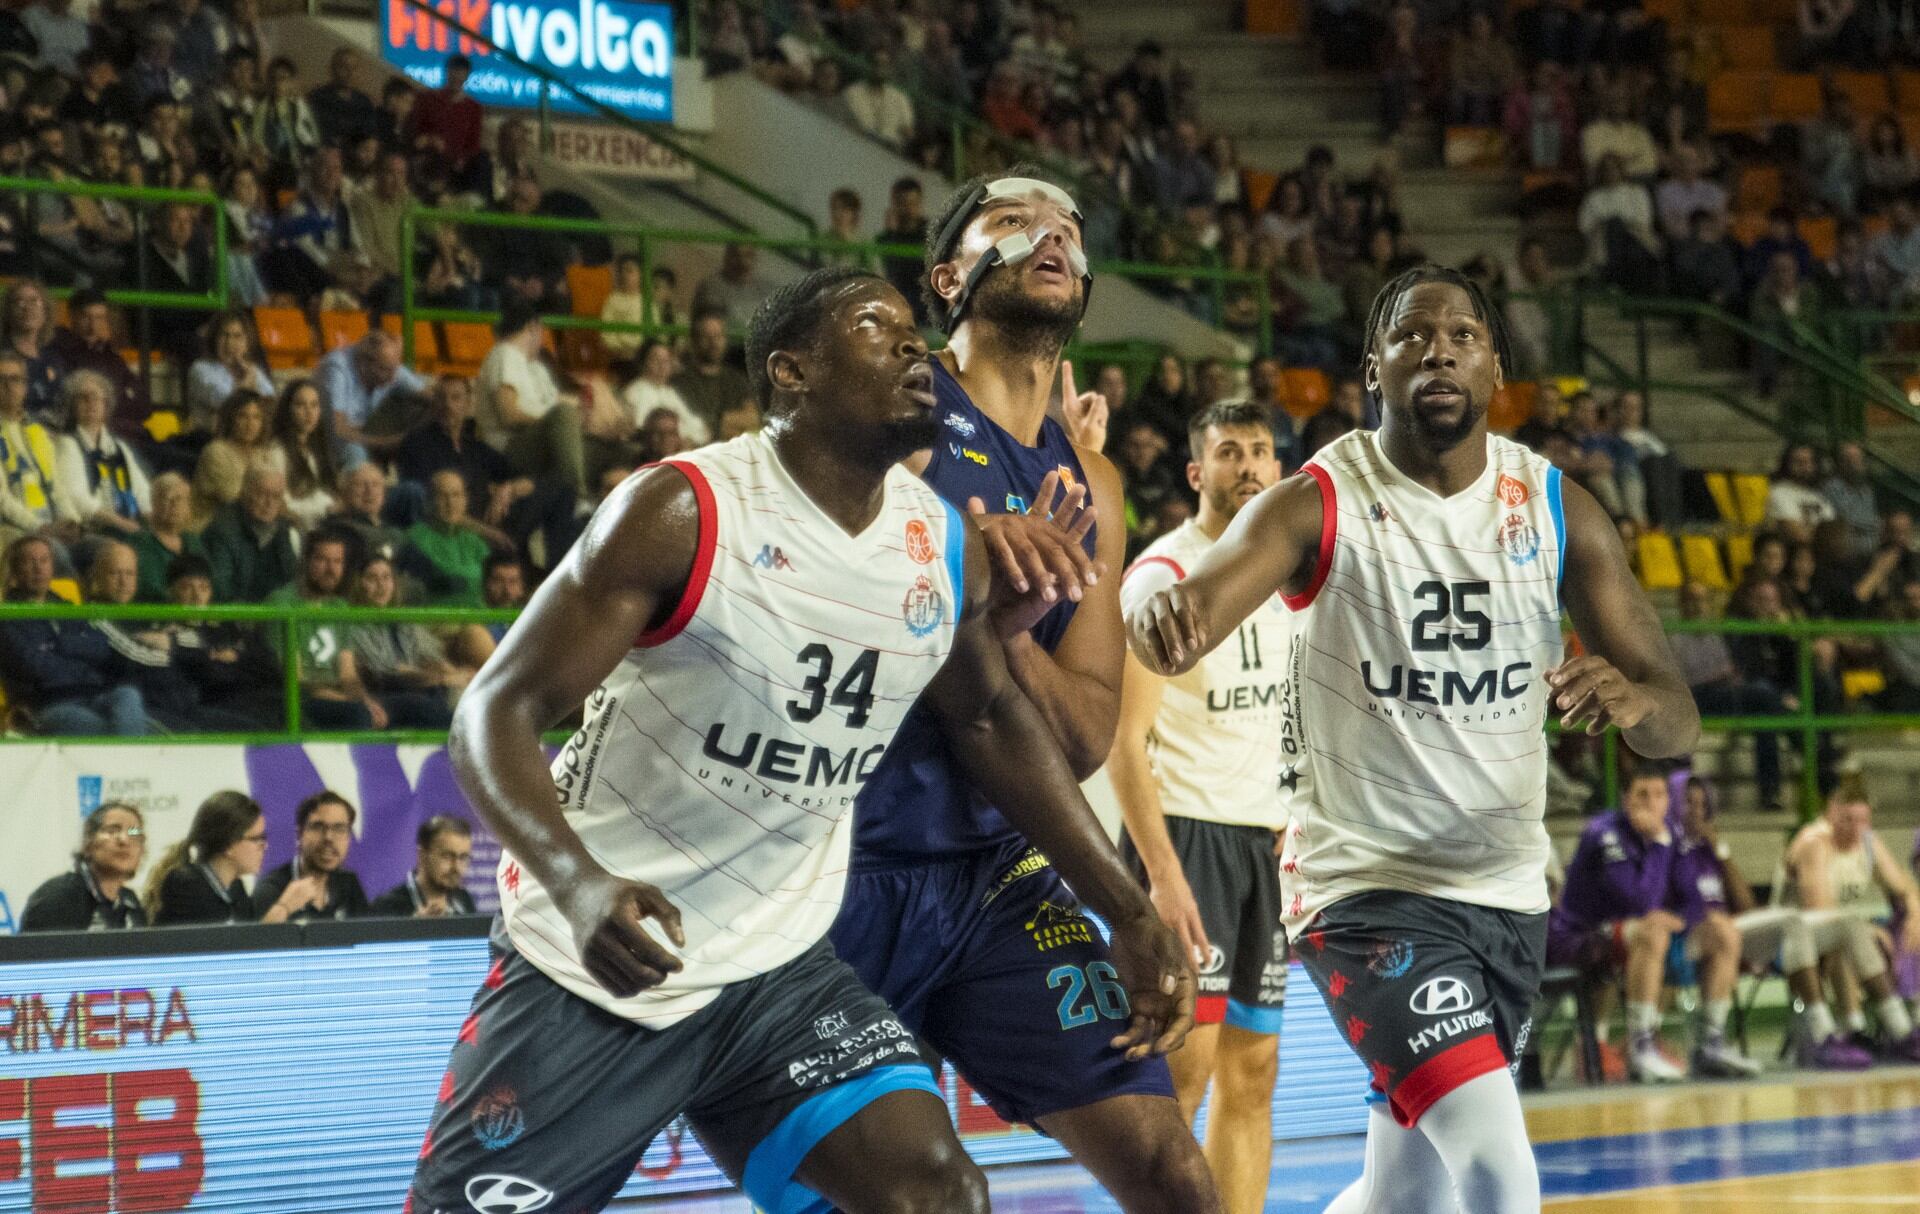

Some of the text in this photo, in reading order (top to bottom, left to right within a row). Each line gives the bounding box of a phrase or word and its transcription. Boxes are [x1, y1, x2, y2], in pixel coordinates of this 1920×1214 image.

[1412, 580, 1492, 652] 25
[1239, 622, 1262, 671] 11
[785, 642, 881, 730] 34
[1360, 660, 1532, 706] UEMC
[595, 731, 604, 743] TU
[1368, 702, 1528, 724] UNIVESIDAD
[703, 722, 886, 788] UEMC
[1000, 854, 1051, 883] OUREN
[1046, 960, 1132, 1031] 26
